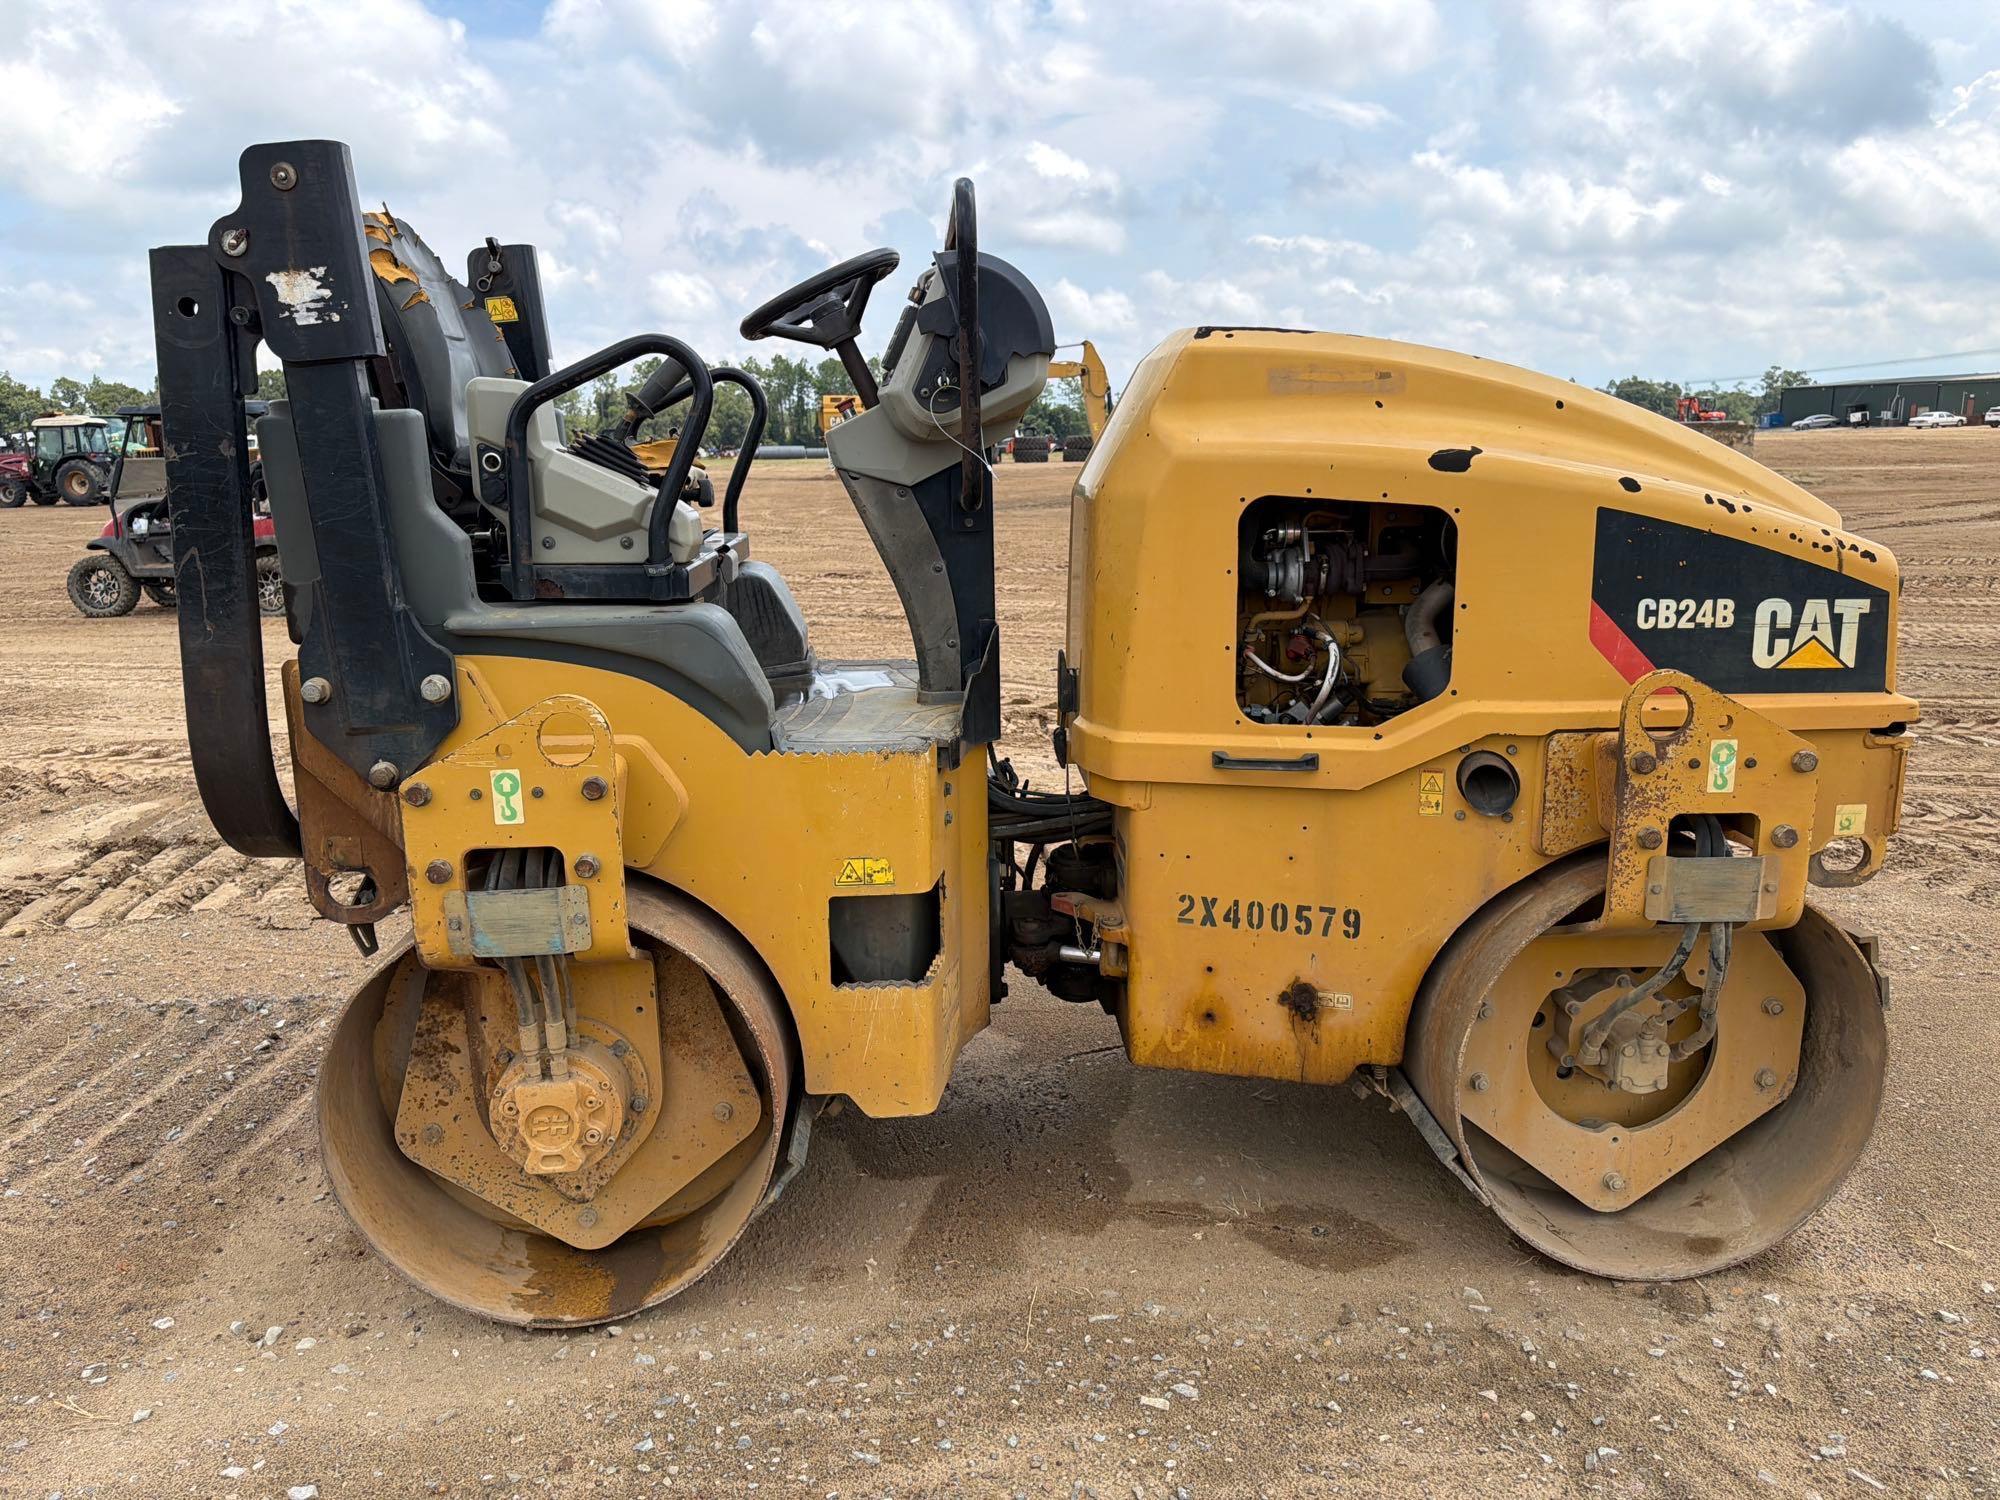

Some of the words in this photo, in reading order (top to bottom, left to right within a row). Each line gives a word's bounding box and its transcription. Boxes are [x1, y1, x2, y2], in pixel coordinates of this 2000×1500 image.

[1636, 598, 1735, 630] CB24B
[1751, 597, 1871, 669] CAT
[1177, 894, 1361, 939] 2X400579
